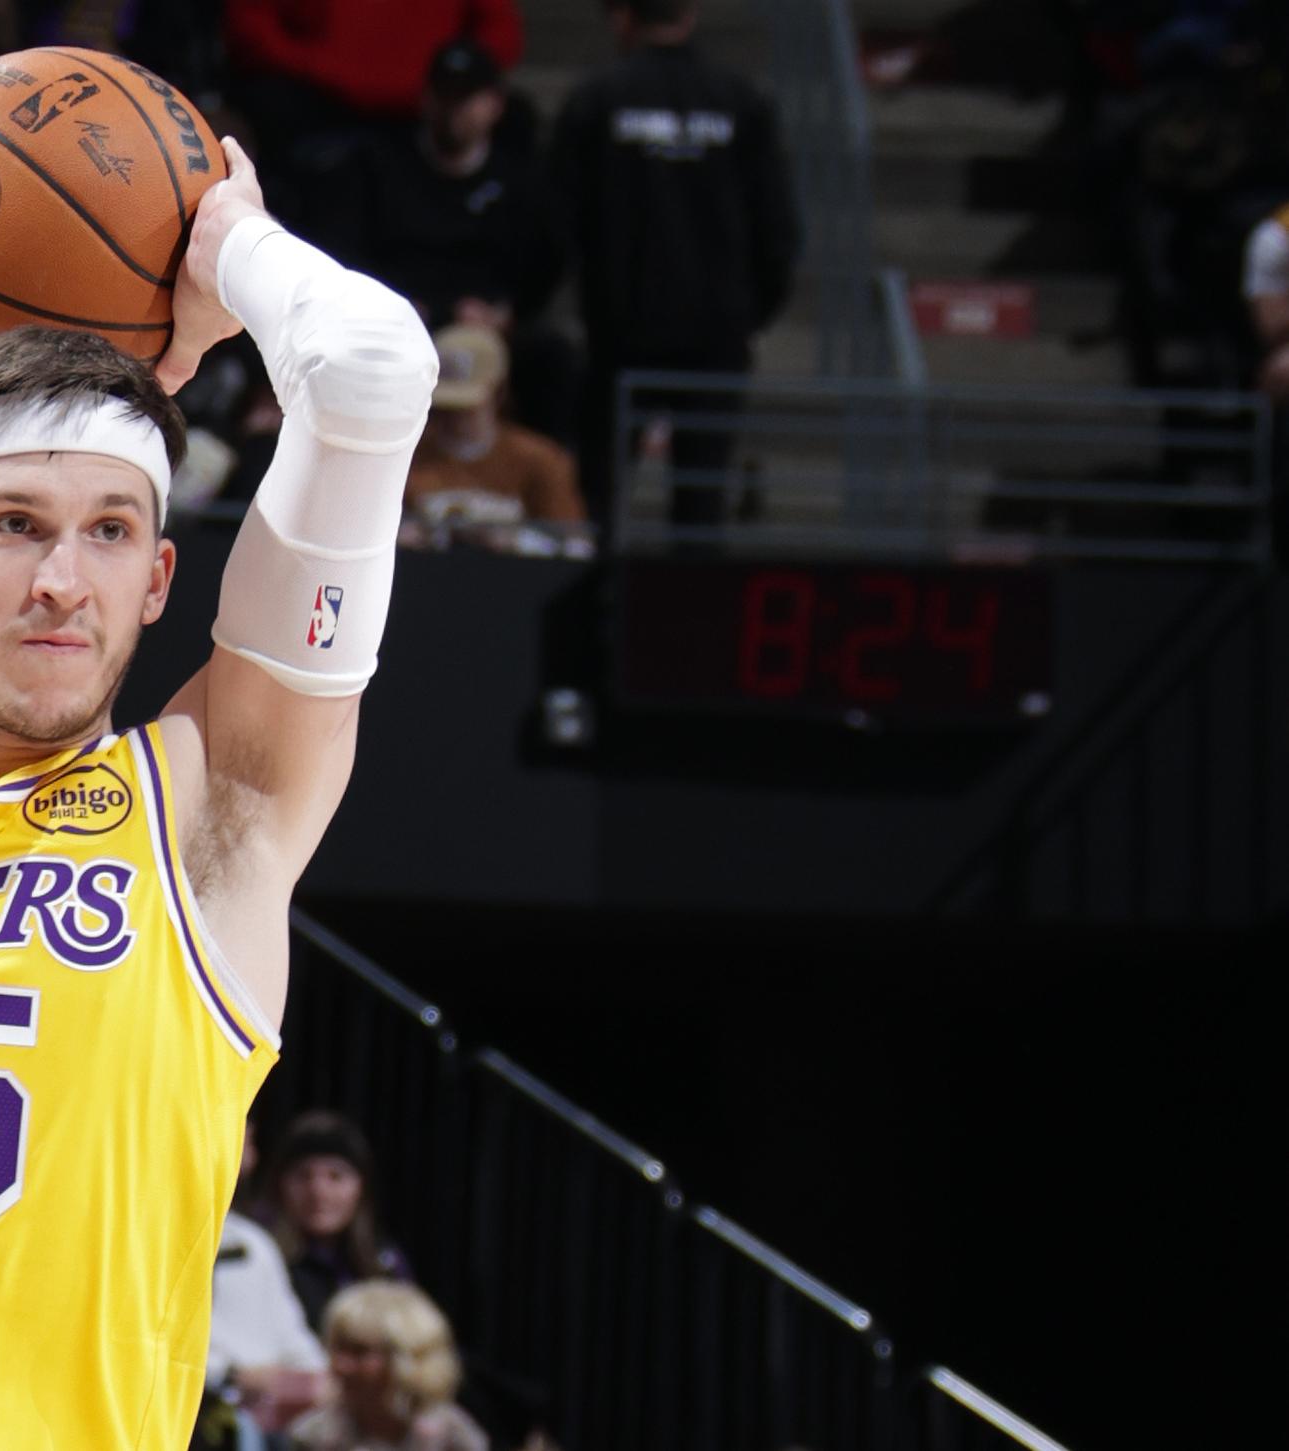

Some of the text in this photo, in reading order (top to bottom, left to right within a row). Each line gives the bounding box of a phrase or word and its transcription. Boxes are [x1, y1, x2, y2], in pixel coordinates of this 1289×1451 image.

[740, 568, 999, 702] 8:24
[34, 783, 125, 814] bibigo
[49, 807, 88, 819] 비비고
